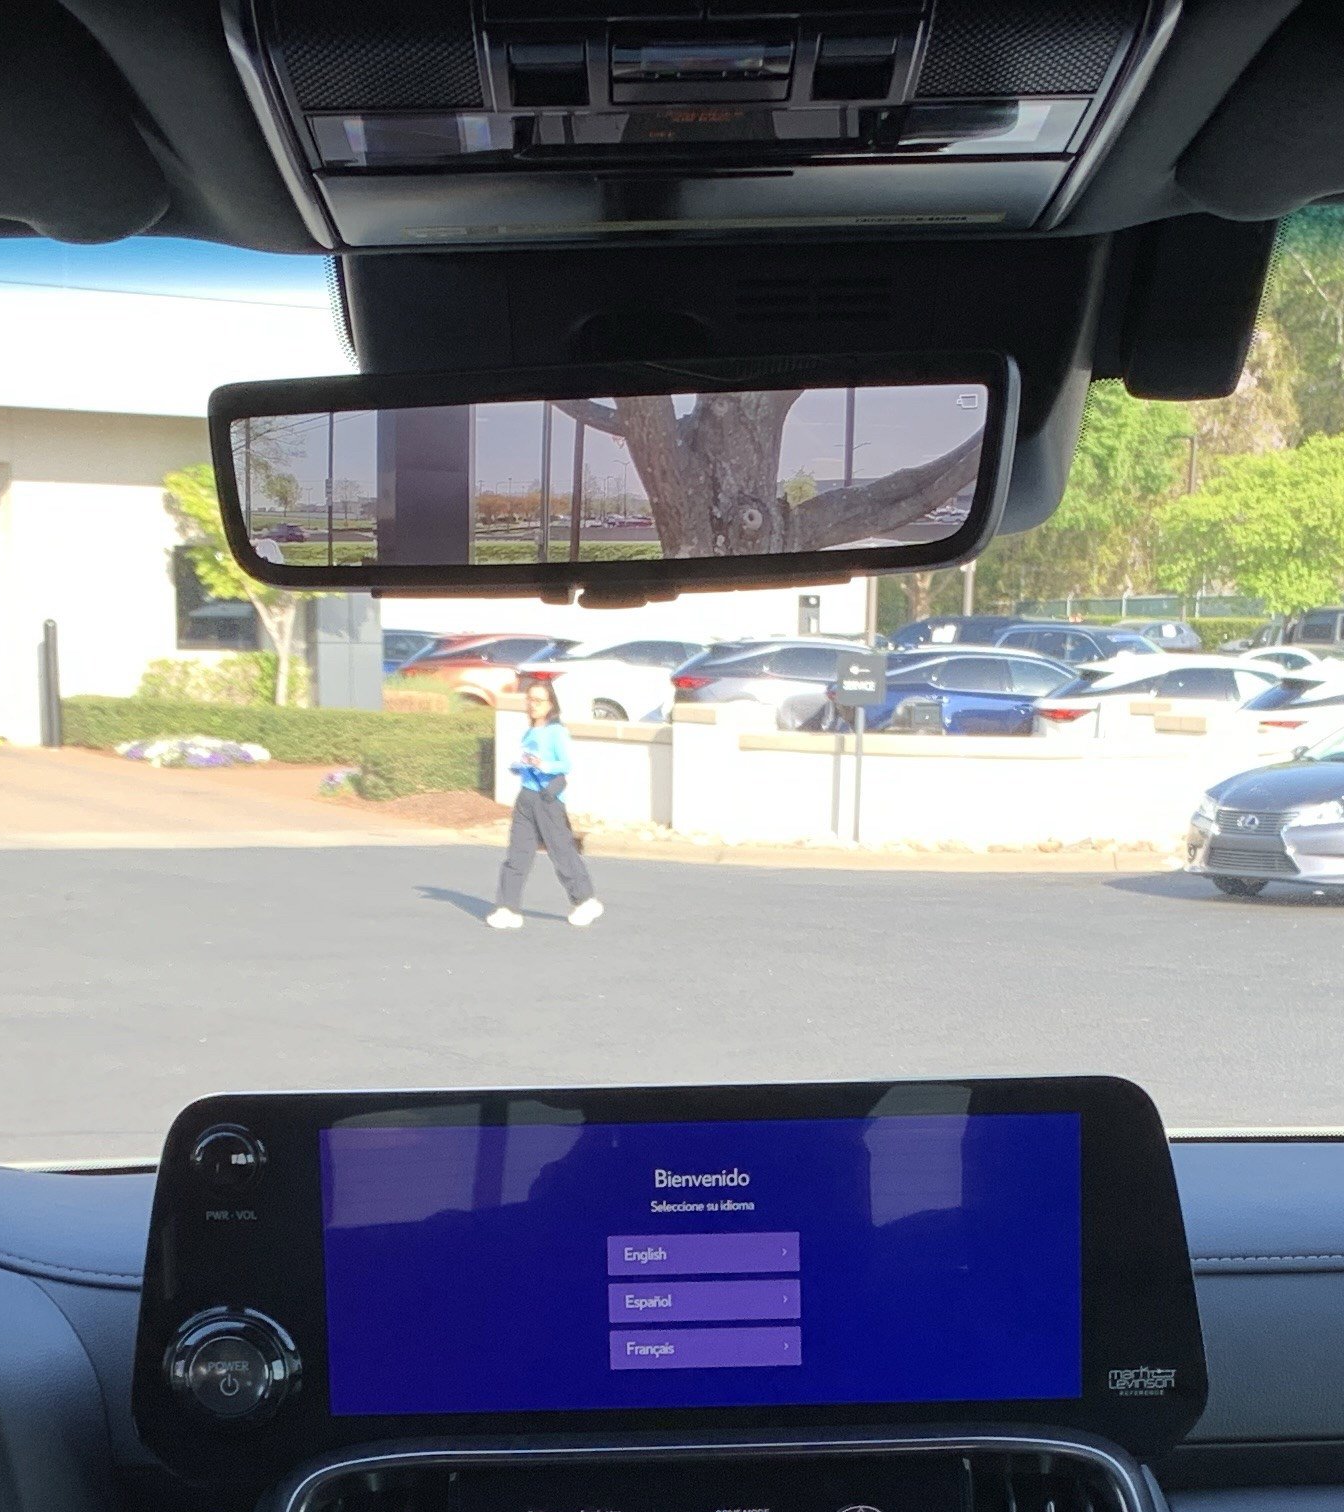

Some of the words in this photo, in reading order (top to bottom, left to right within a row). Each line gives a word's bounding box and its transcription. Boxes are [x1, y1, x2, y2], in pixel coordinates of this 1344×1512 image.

[655, 1168, 750, 1188] Bienvenido
[651, 1200, 704, 1212] Seleccione
[706, 1203, 719, 1211] su
[720, 1200, 755, 1211] idioma
[624, 1247, 667, 1264] English
[625, 1294, 672, 1310] Español
[626, 1342, 675, 1358] Français
[208, 1361, 249, 1372] POWER
